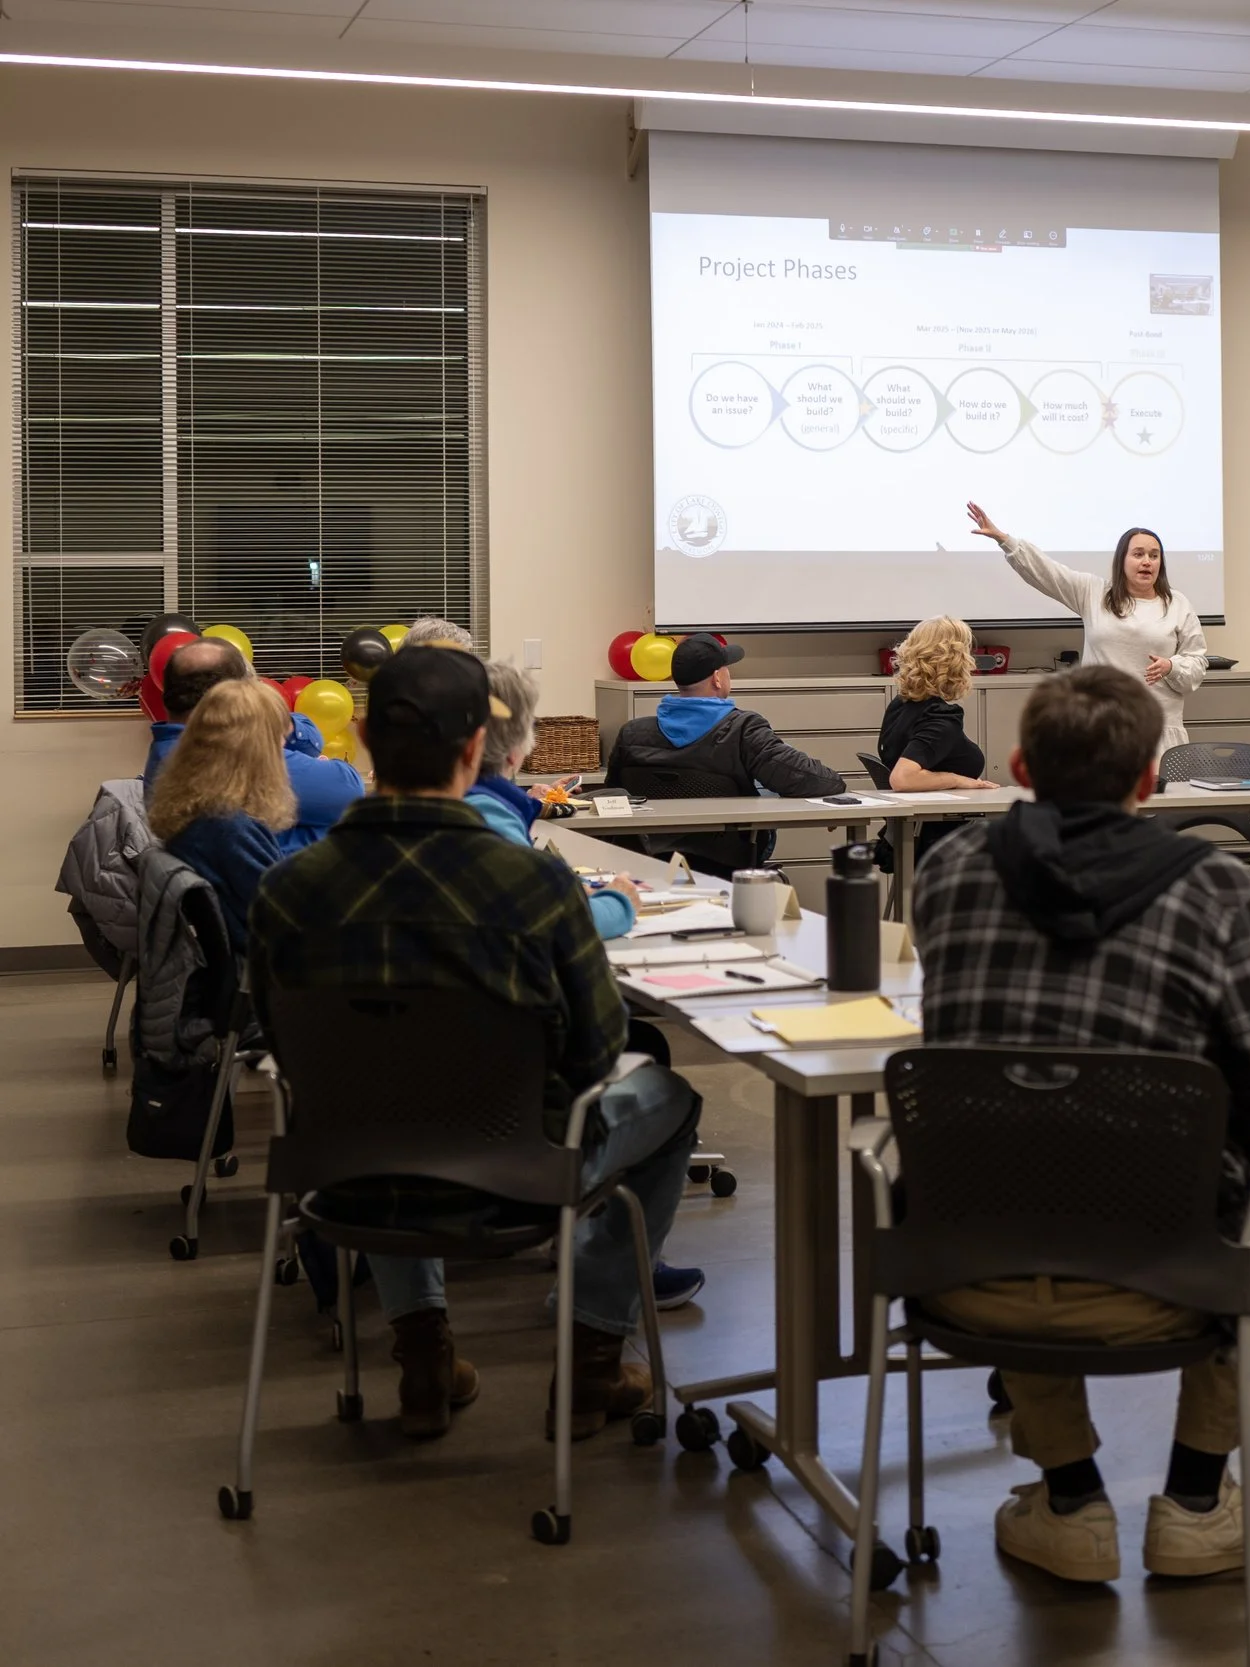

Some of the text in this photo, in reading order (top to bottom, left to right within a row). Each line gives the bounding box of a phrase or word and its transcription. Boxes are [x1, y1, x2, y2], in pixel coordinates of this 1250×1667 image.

[698, 255, 857, 282] Project Phases
[767, 321, 784, 329] 2024
[805, 321, 824, 330] 2025
[916, 325, 931, 333] Mar
[932, 325, 949, 333] 2025
[974, 326, 991, 334] 2025
[1001, 327, 1017, 336] May
[769, 340, 796, 350] Phase
[957, 343, 984, 353] Phase
[807, 382, 832, 391] What
[886, 384, 911, 393] What
[705, 393, 720, 403] Do
[737, 394, 759, 403] have
[797, 394, 843, 404] should we
[876, 395, 921, 405] should we
[959, 399, 1007, 409] How do we
[1043, 401, 1088, 411] How much
[711, 405, 754, 415] an issue?
[806, 406, 834, 416] build?
[885, 408, 913, 417] build?
[1130, 408, 1163, 418] Execute
[965, 411, 1001, 421] build it?
[1042, 412, 1090, 422] will it cost?
[800, 424, 840, 435] (general)
[880, 424, 919, 436] (specific)
[686, 496, 705, 505] LAKE
